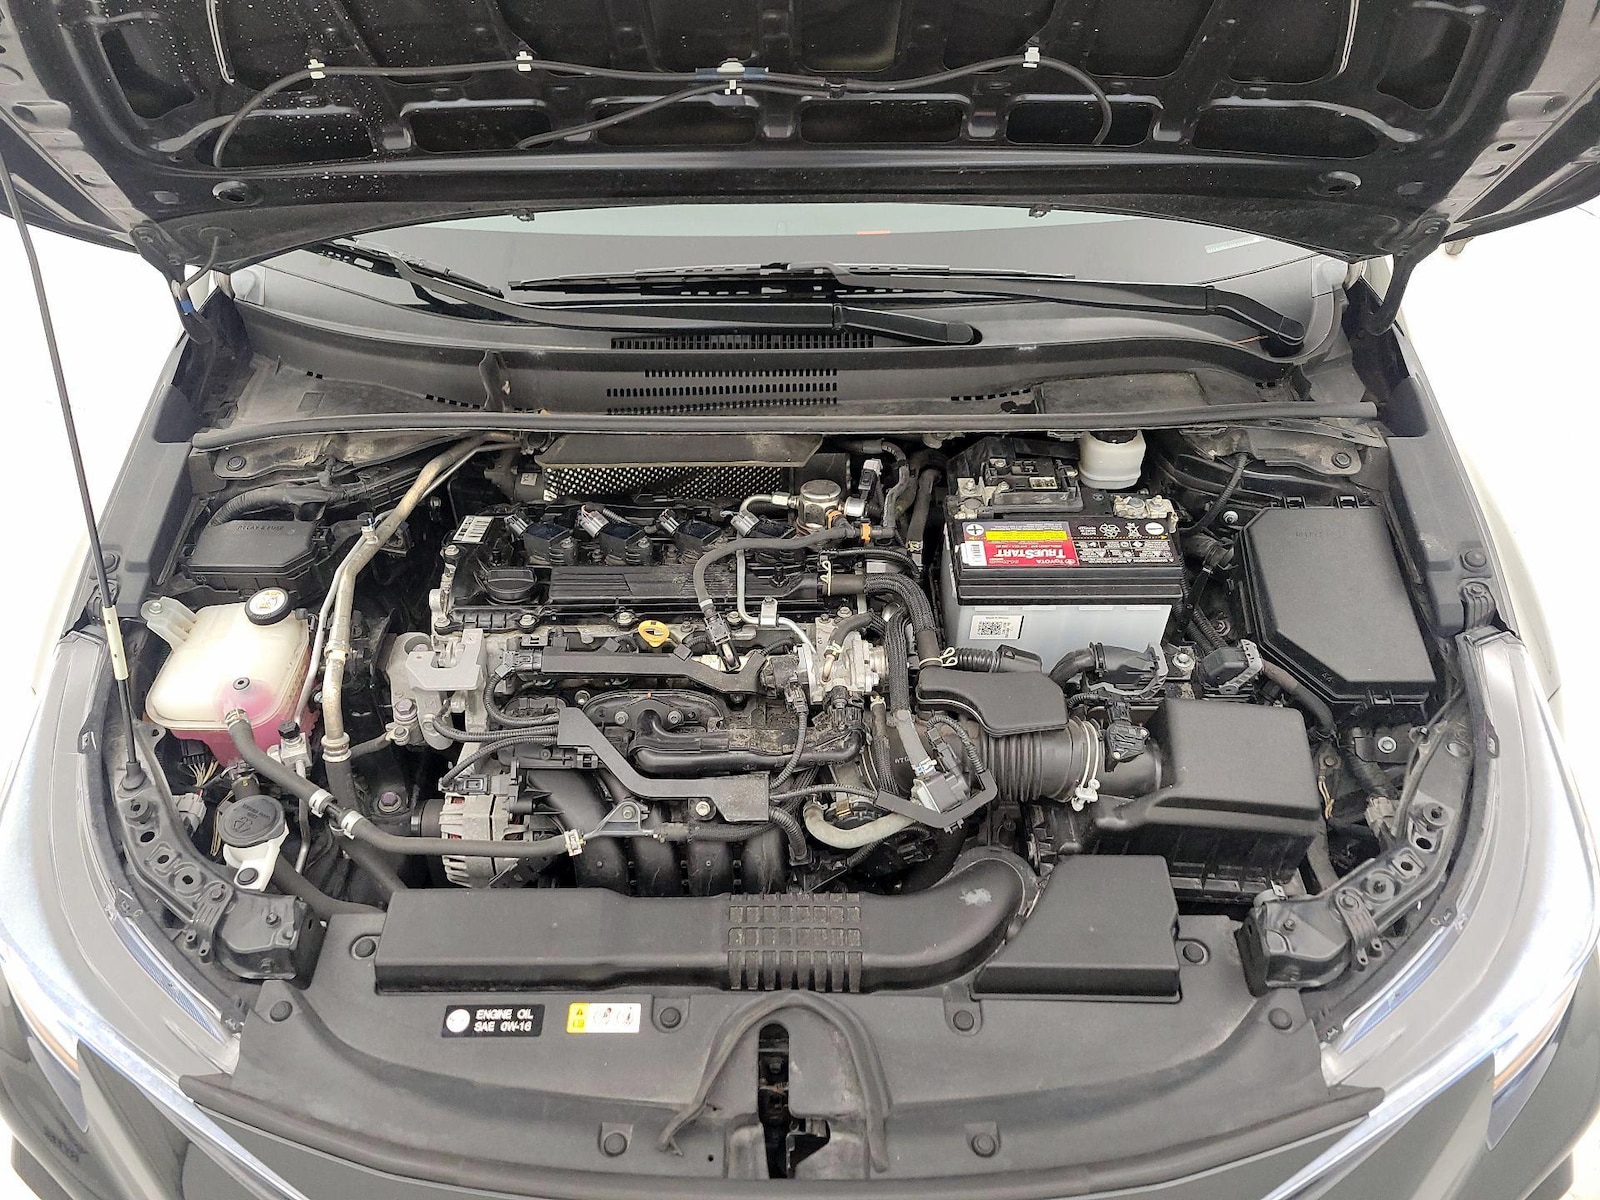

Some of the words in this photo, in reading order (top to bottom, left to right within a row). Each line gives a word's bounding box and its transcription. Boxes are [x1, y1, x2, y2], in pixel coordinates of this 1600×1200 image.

[475, 1008, 513, 1020] ENGINE
[517, 1008, 534, 1020] OIL
[473, 1021, 495, 1032] SAE
[500, 1021, 532, 1032] 0W-16
